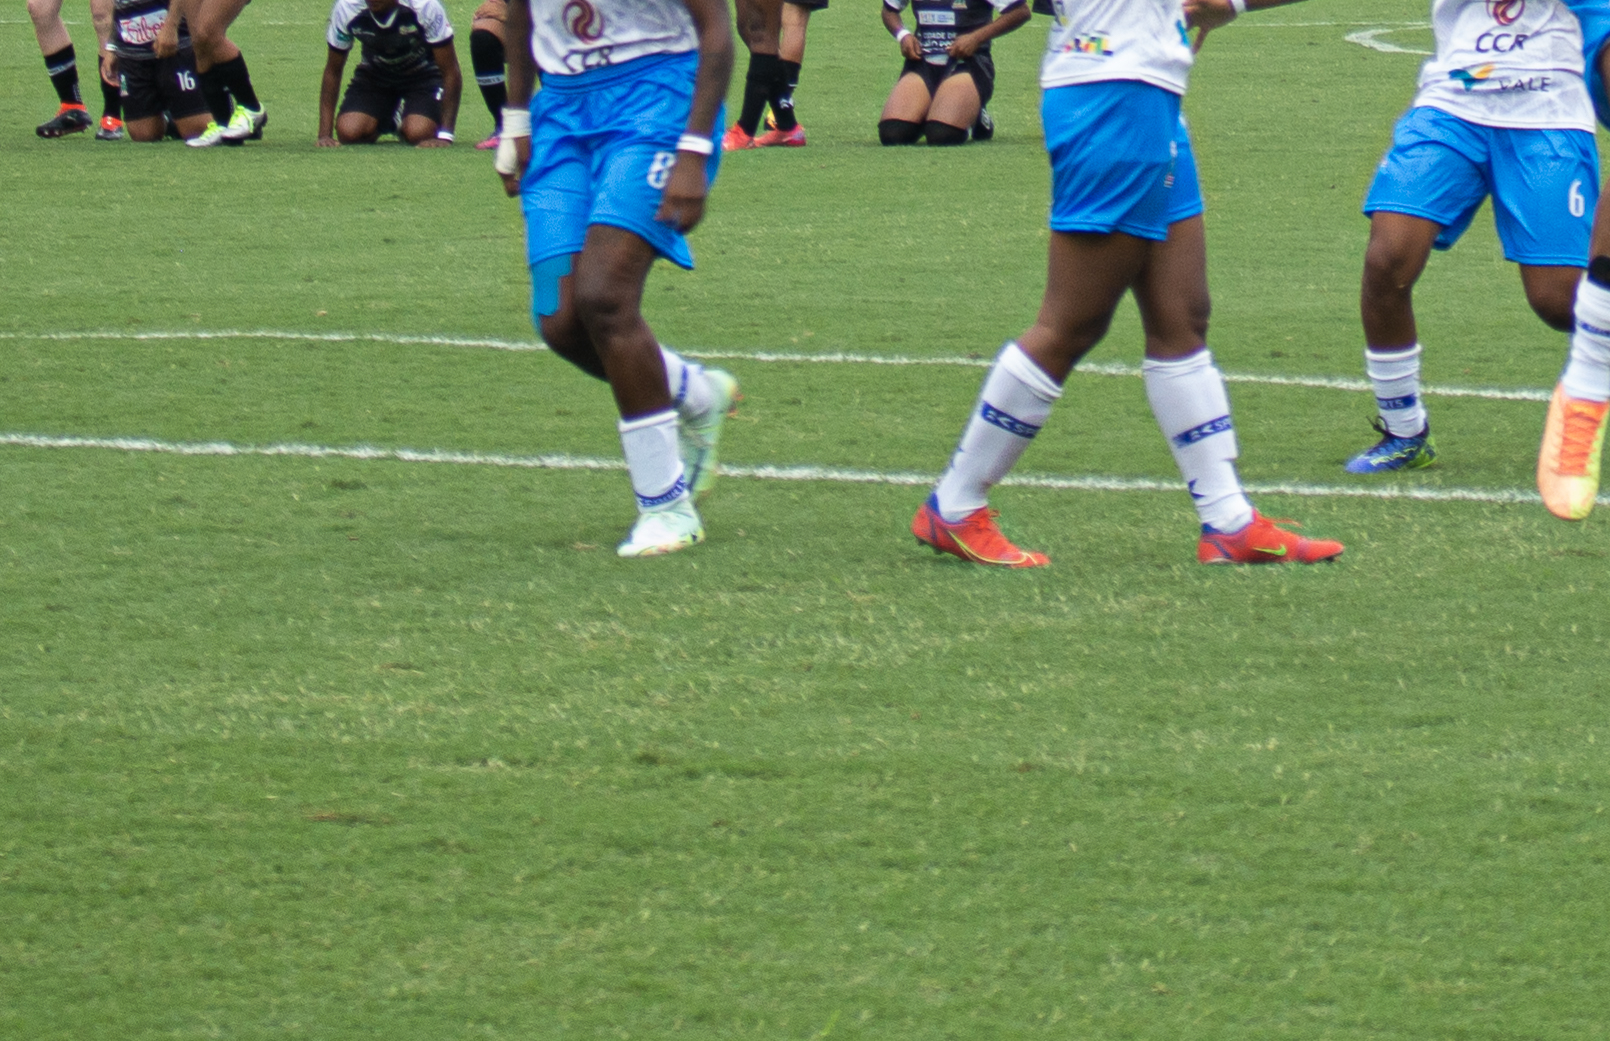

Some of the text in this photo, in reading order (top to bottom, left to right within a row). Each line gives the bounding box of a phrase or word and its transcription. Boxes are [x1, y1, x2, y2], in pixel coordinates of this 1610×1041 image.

[1475, 32, 1529, 54] CCR
[177, 70, 196, 92] 16
[1499, 76, 1552, 93] VALE
[1568, 179, 1586, 217] 6
